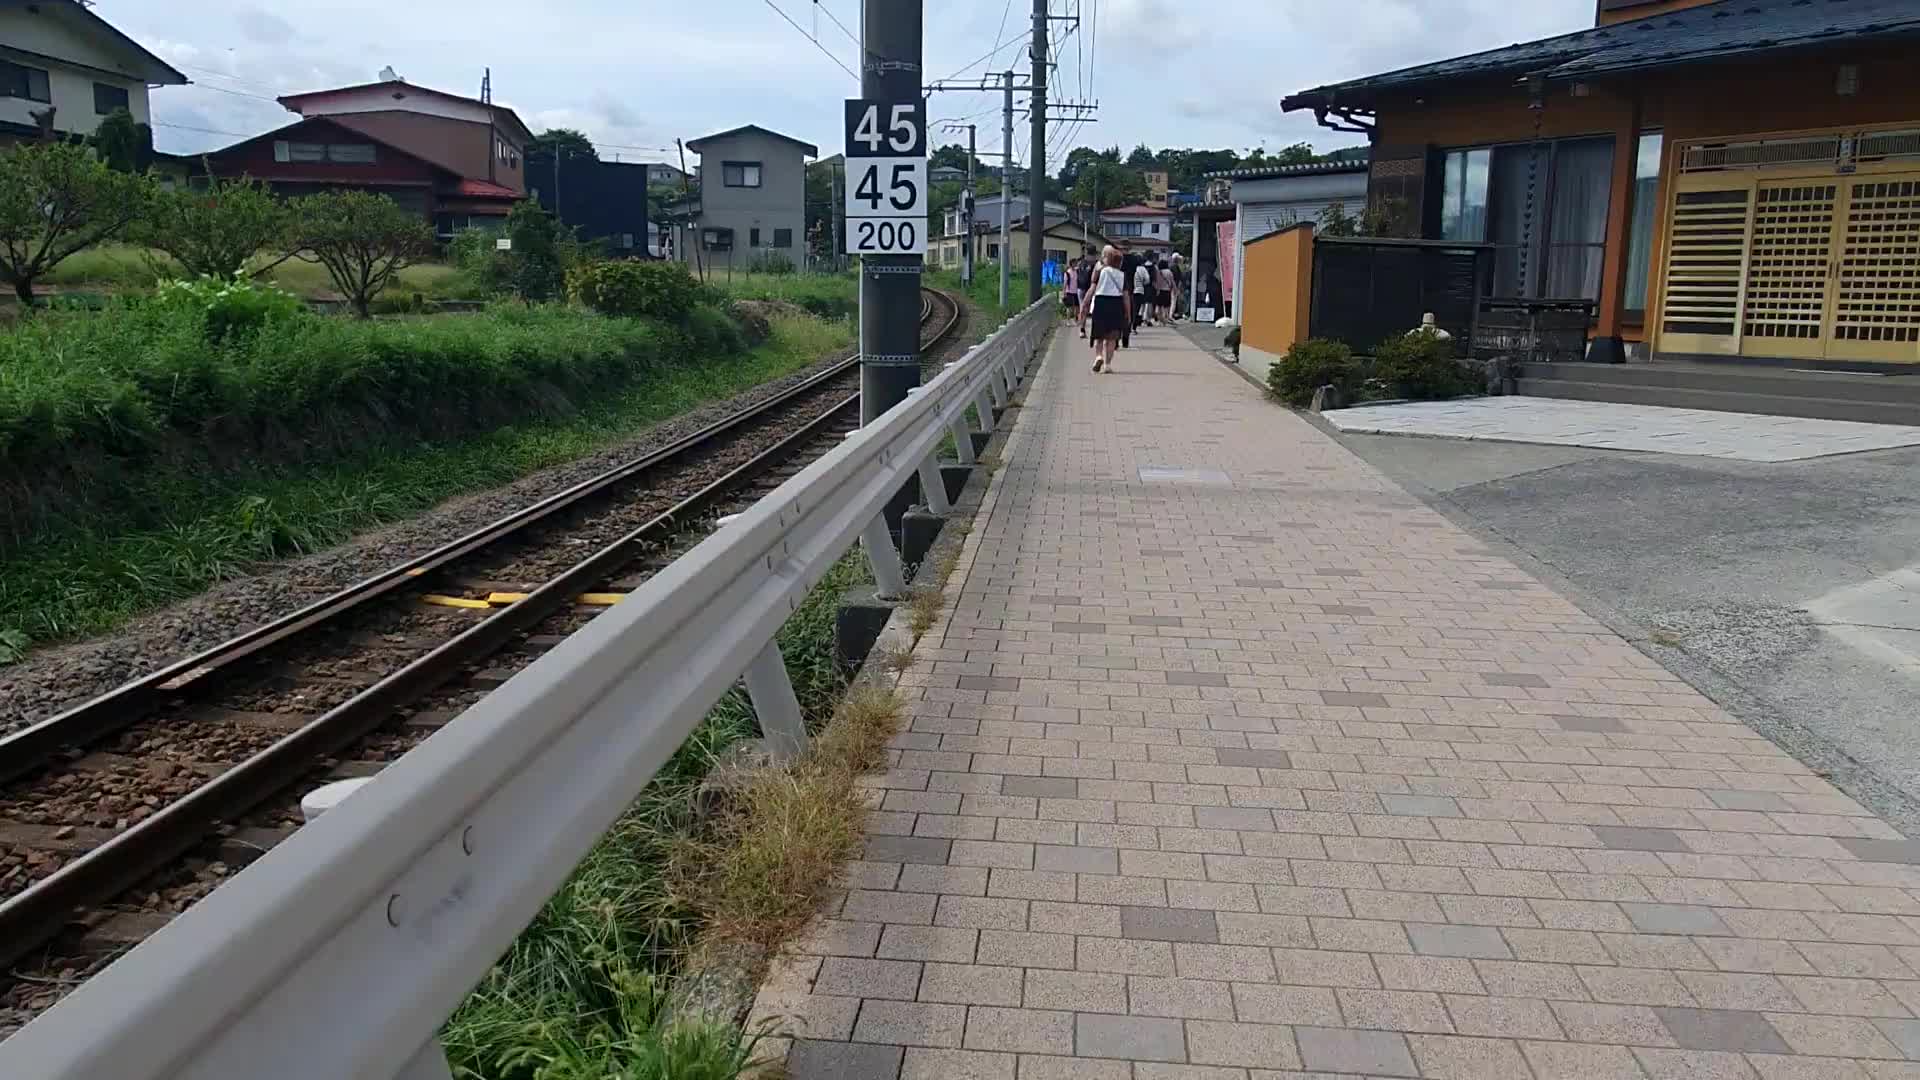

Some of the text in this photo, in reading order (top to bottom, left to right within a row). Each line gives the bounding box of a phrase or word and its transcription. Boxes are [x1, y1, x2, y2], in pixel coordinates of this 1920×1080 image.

[854, 104, 917, 152] 45
[855, 164, 917, 210] 45
[858, 221, 915, 251] 200
